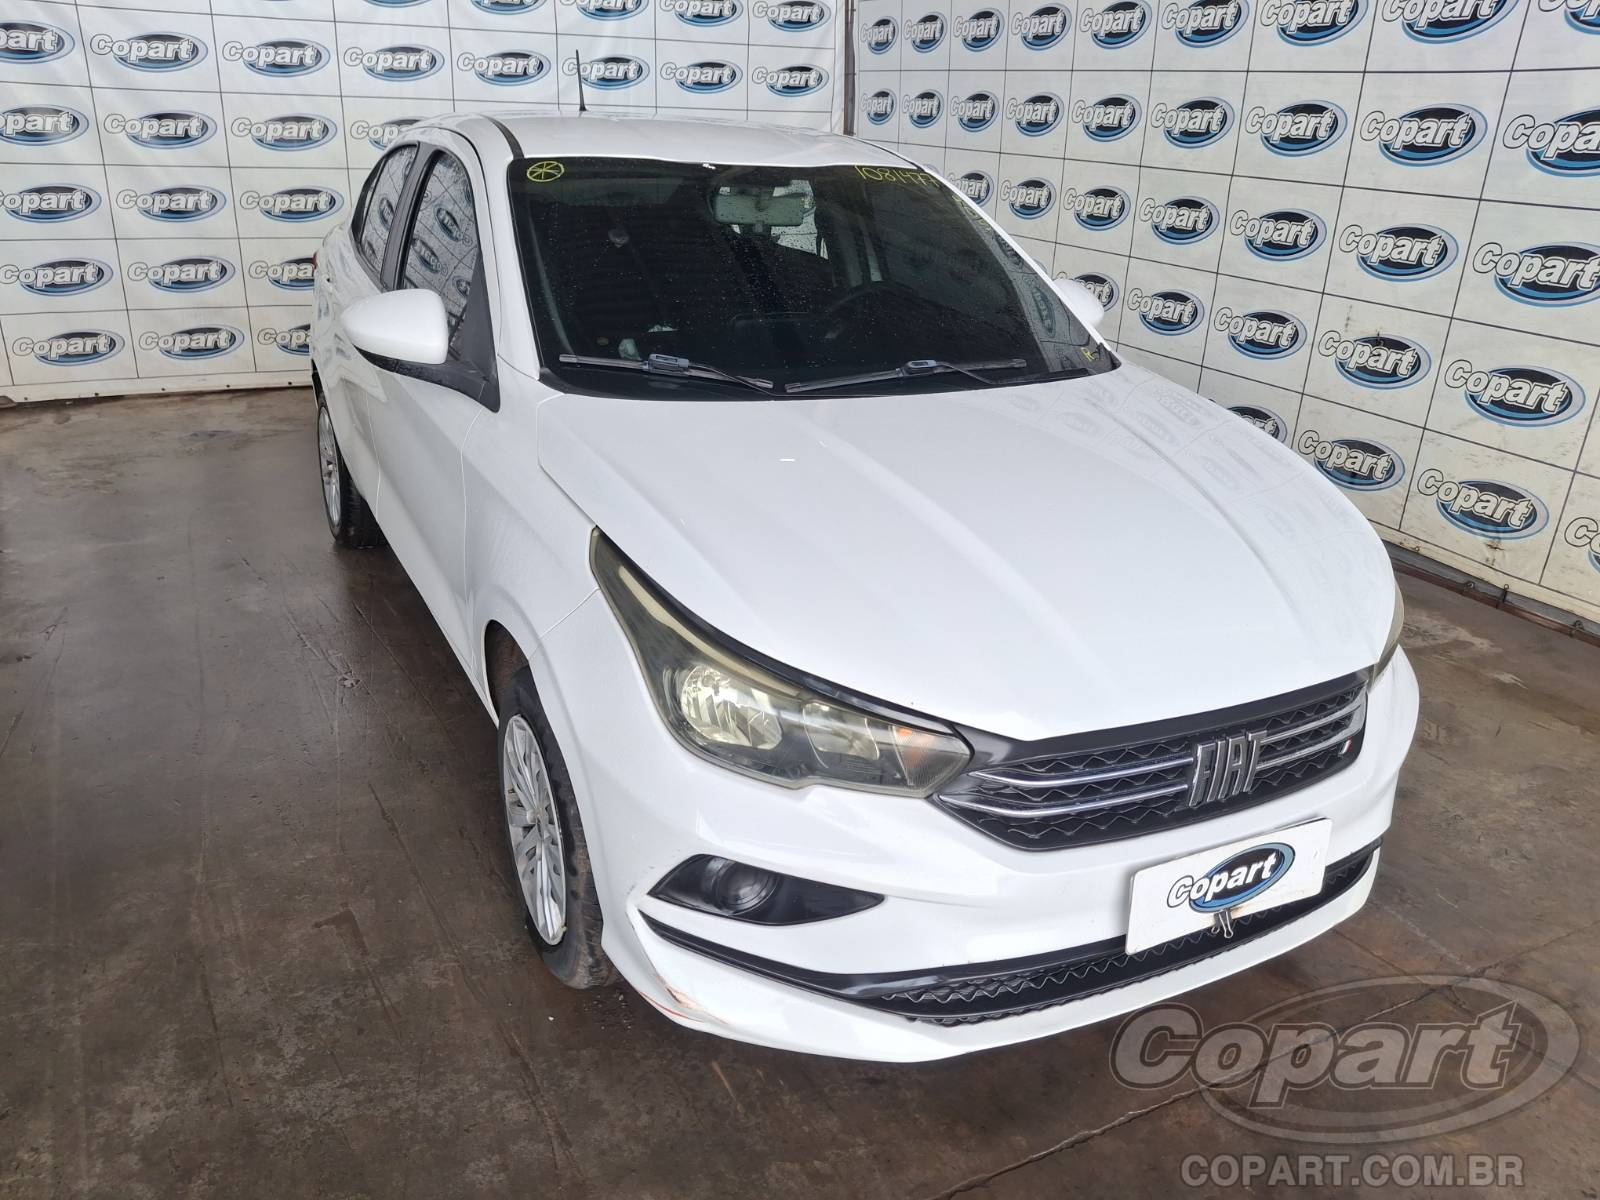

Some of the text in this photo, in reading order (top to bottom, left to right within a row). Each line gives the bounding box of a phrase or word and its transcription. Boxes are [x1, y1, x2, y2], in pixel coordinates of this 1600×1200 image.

[660, 0, 732, 17] Copart
[752, 1, 821, 24] Copart
[1080, 5, 1145, 39] Copart
[1162, 1, 1238, 38] Copart
[1261, 0, 1351, 35] Copart
[861, 21, 895, 47] Copart
[903, 16, 942, 46] Copart
[953, 12, 999, 44] Copart
[1011, 8, 1065, 41] Copart
[90, 34, 195, 62] Copart
[223, 41, 317, 67] Copart
[343, 46, 433, 74] Copart
[457, 52, 540, 76] Copart
[562, 57, 640, 81] Copart
[660, 62, 732, 85] Copart
[752, 66, 820, 89] Copart
[861, 93, 892, 119] Copart
[902, 94, 939, 121] Copart
[951, 95, 994, 126] Copart
[1006, 97, 1057, 127] Copart
[1072, 99, 1135, 131] Copart
[1151, 102, 1227, 136] Copart
[104, 113, 204, 140] Copart
[231, 117, 326, 143] Copart
[1245, 106, 1336, 143] Copart
[1360, 110, 1474, 151] Copart
[116, 189, 212, 215] Copart
[240, 190, 332, 215] Copart
[1000, 180, 1051, 208] Copart
[1063, 187, 1125, 218] Copart
[1139, 197, 1210, 232] Copart
[1230, 210, 1317, 247] Copart
[1339, 224, 1445, 267] Copart
[0, 262, 100, 289] Copart
[127, 260, 223, 283] Copart
[1473, 242, 1600, 291] Copart
[1127, 288, 1198, 325] Copart
[139, 328, 232, 351] Copart
[1213, 307, 1298, 348] Copart
[12, 334, 111, 361] Copart
[1318, 330, 1419, 377] Copart
[1444, 359, 1569, 414] Copart
[1298, 430, 1394, 482] Copart
[1417, 468, 1534, 529] Copart
[1189, 729, 1268, 808] FIAT
[1167, 848, 1281, 908] Copart
